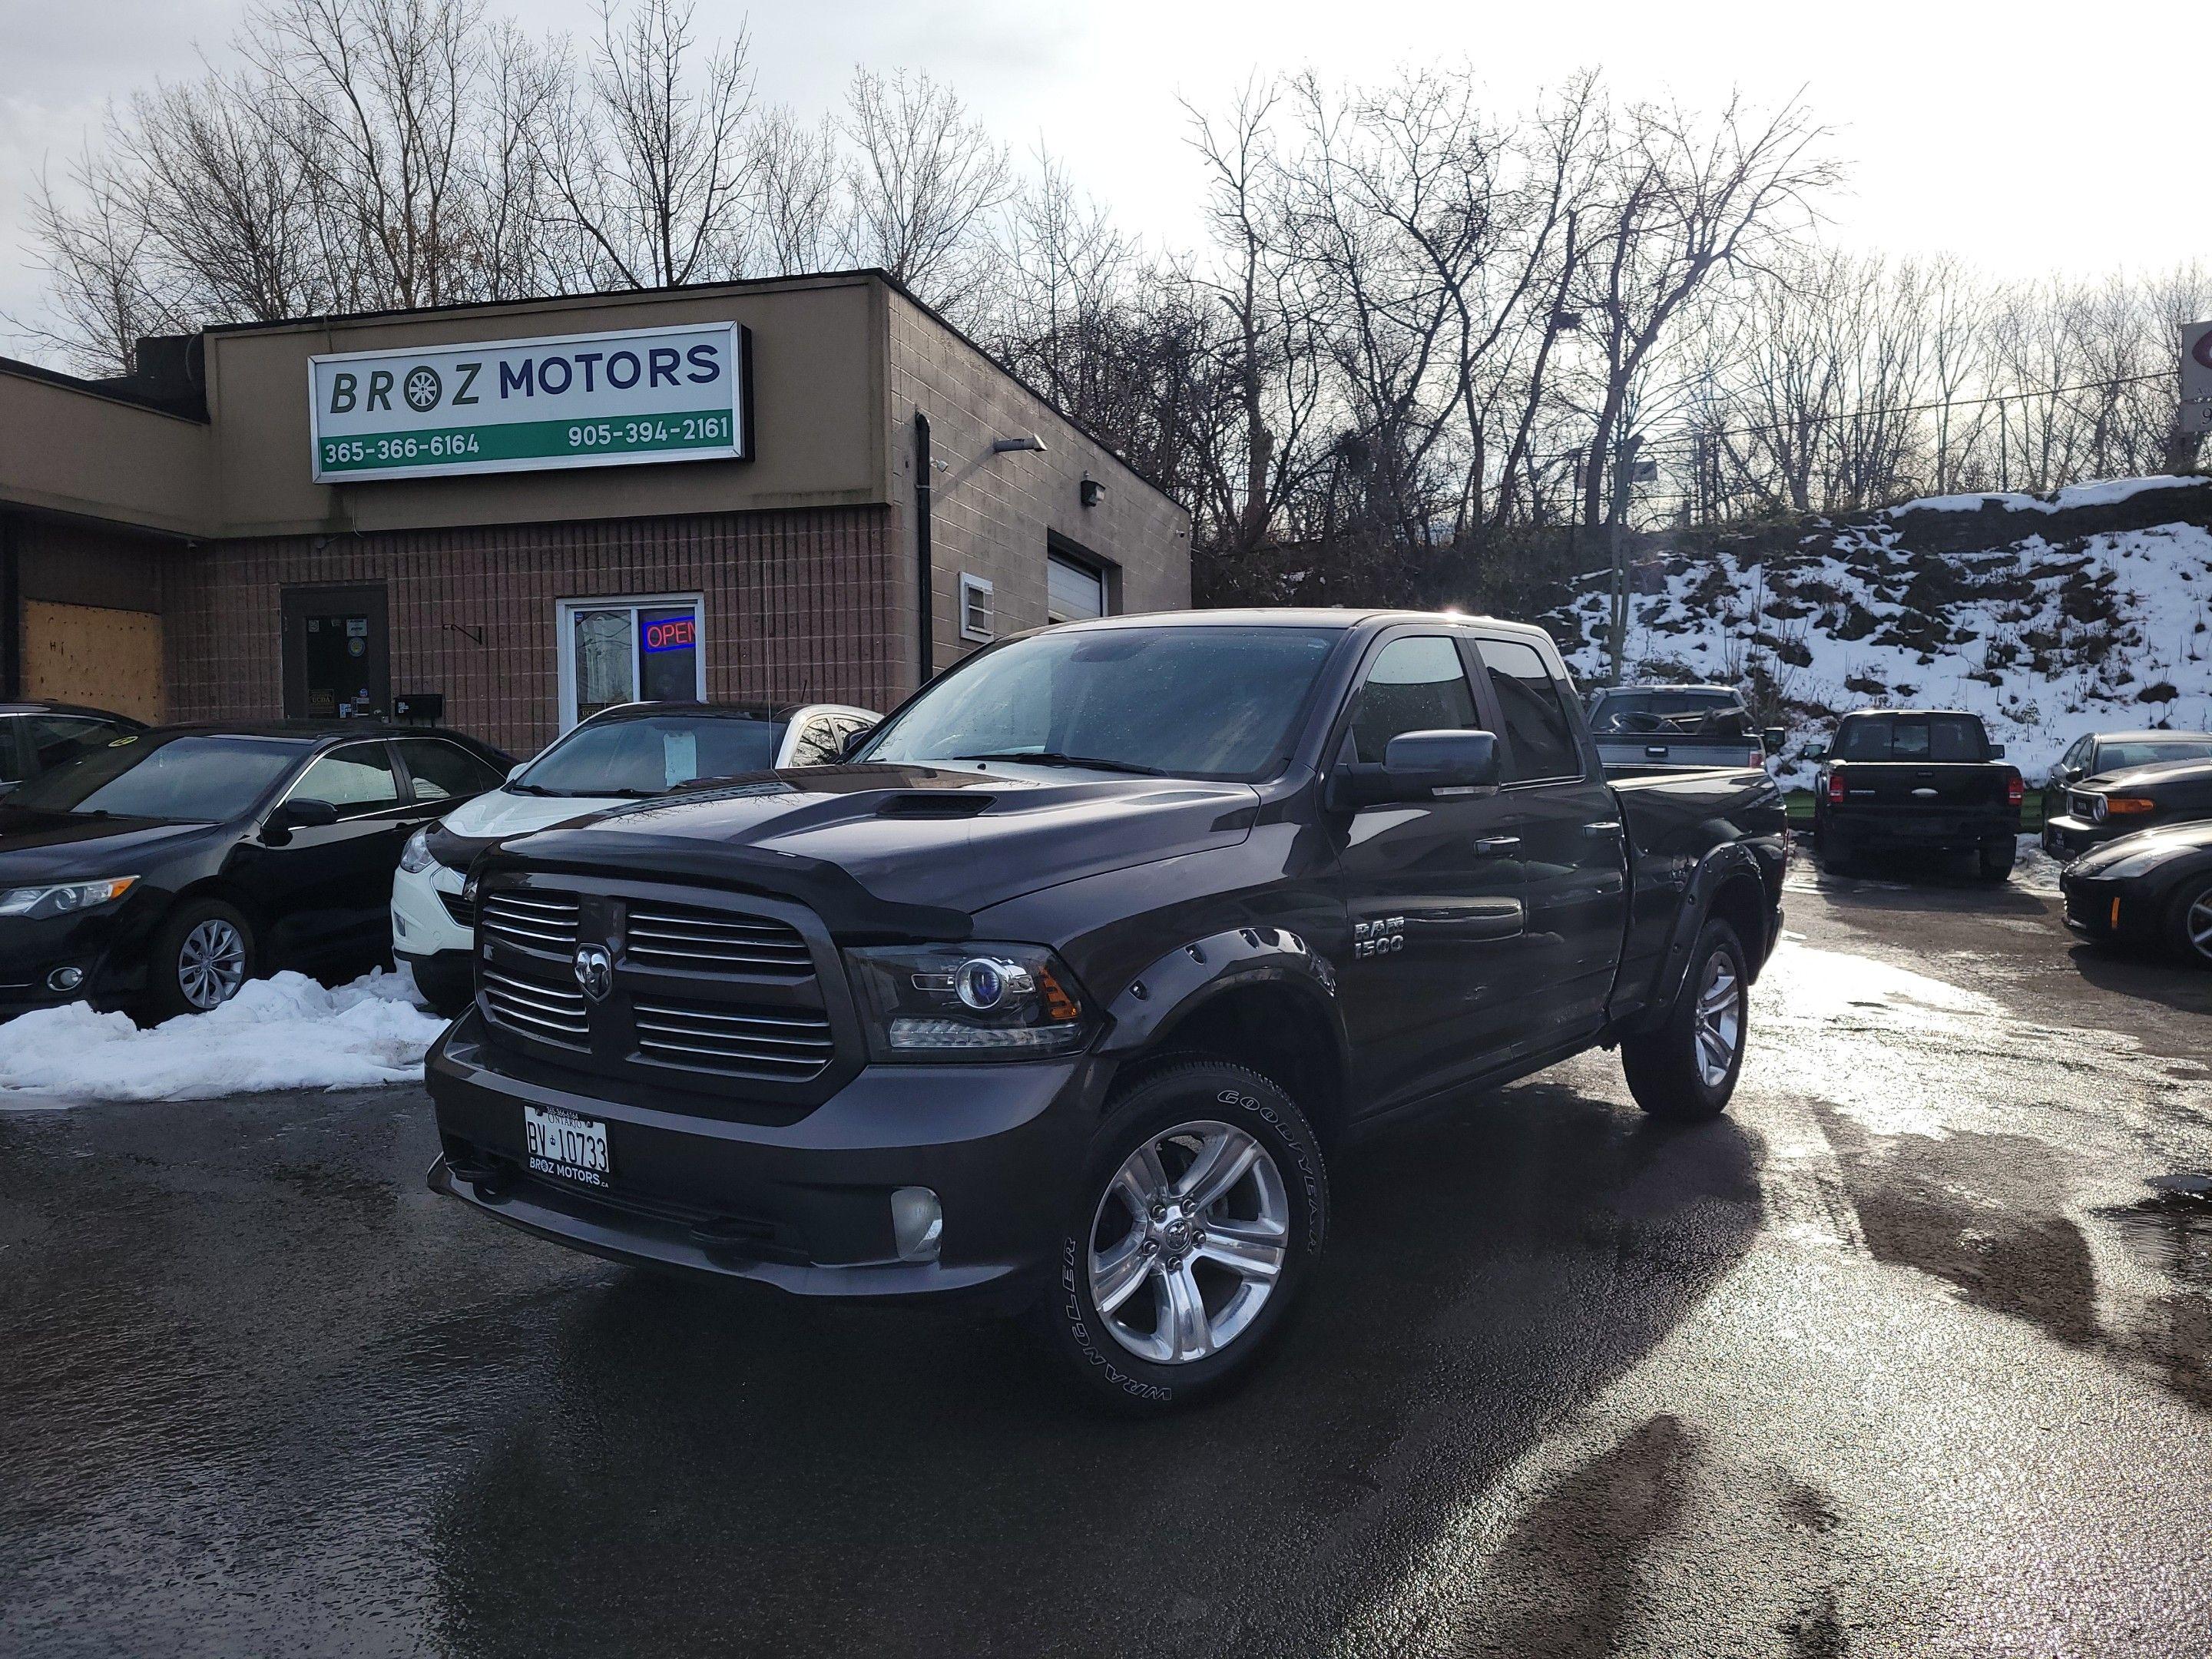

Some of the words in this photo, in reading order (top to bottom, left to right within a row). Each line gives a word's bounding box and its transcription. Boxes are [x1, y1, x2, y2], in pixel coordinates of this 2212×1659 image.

[330, 363, 482, 414] BROZ
[499, 344, 720, 399] MOTORS
[326, 432, 479, 464] 365-366-6164
[568, 416, 728, 447] 905-394-2161
[1354, 916, 1405, 941] RAM
[1354, 935, 1404, 959] 1500
[559, 1128, 608, 1171] 10733
[1217, 1090, 1320, 1255] GOODYEAR
[1061, 1237, 1172, 1401] WRANGLER
